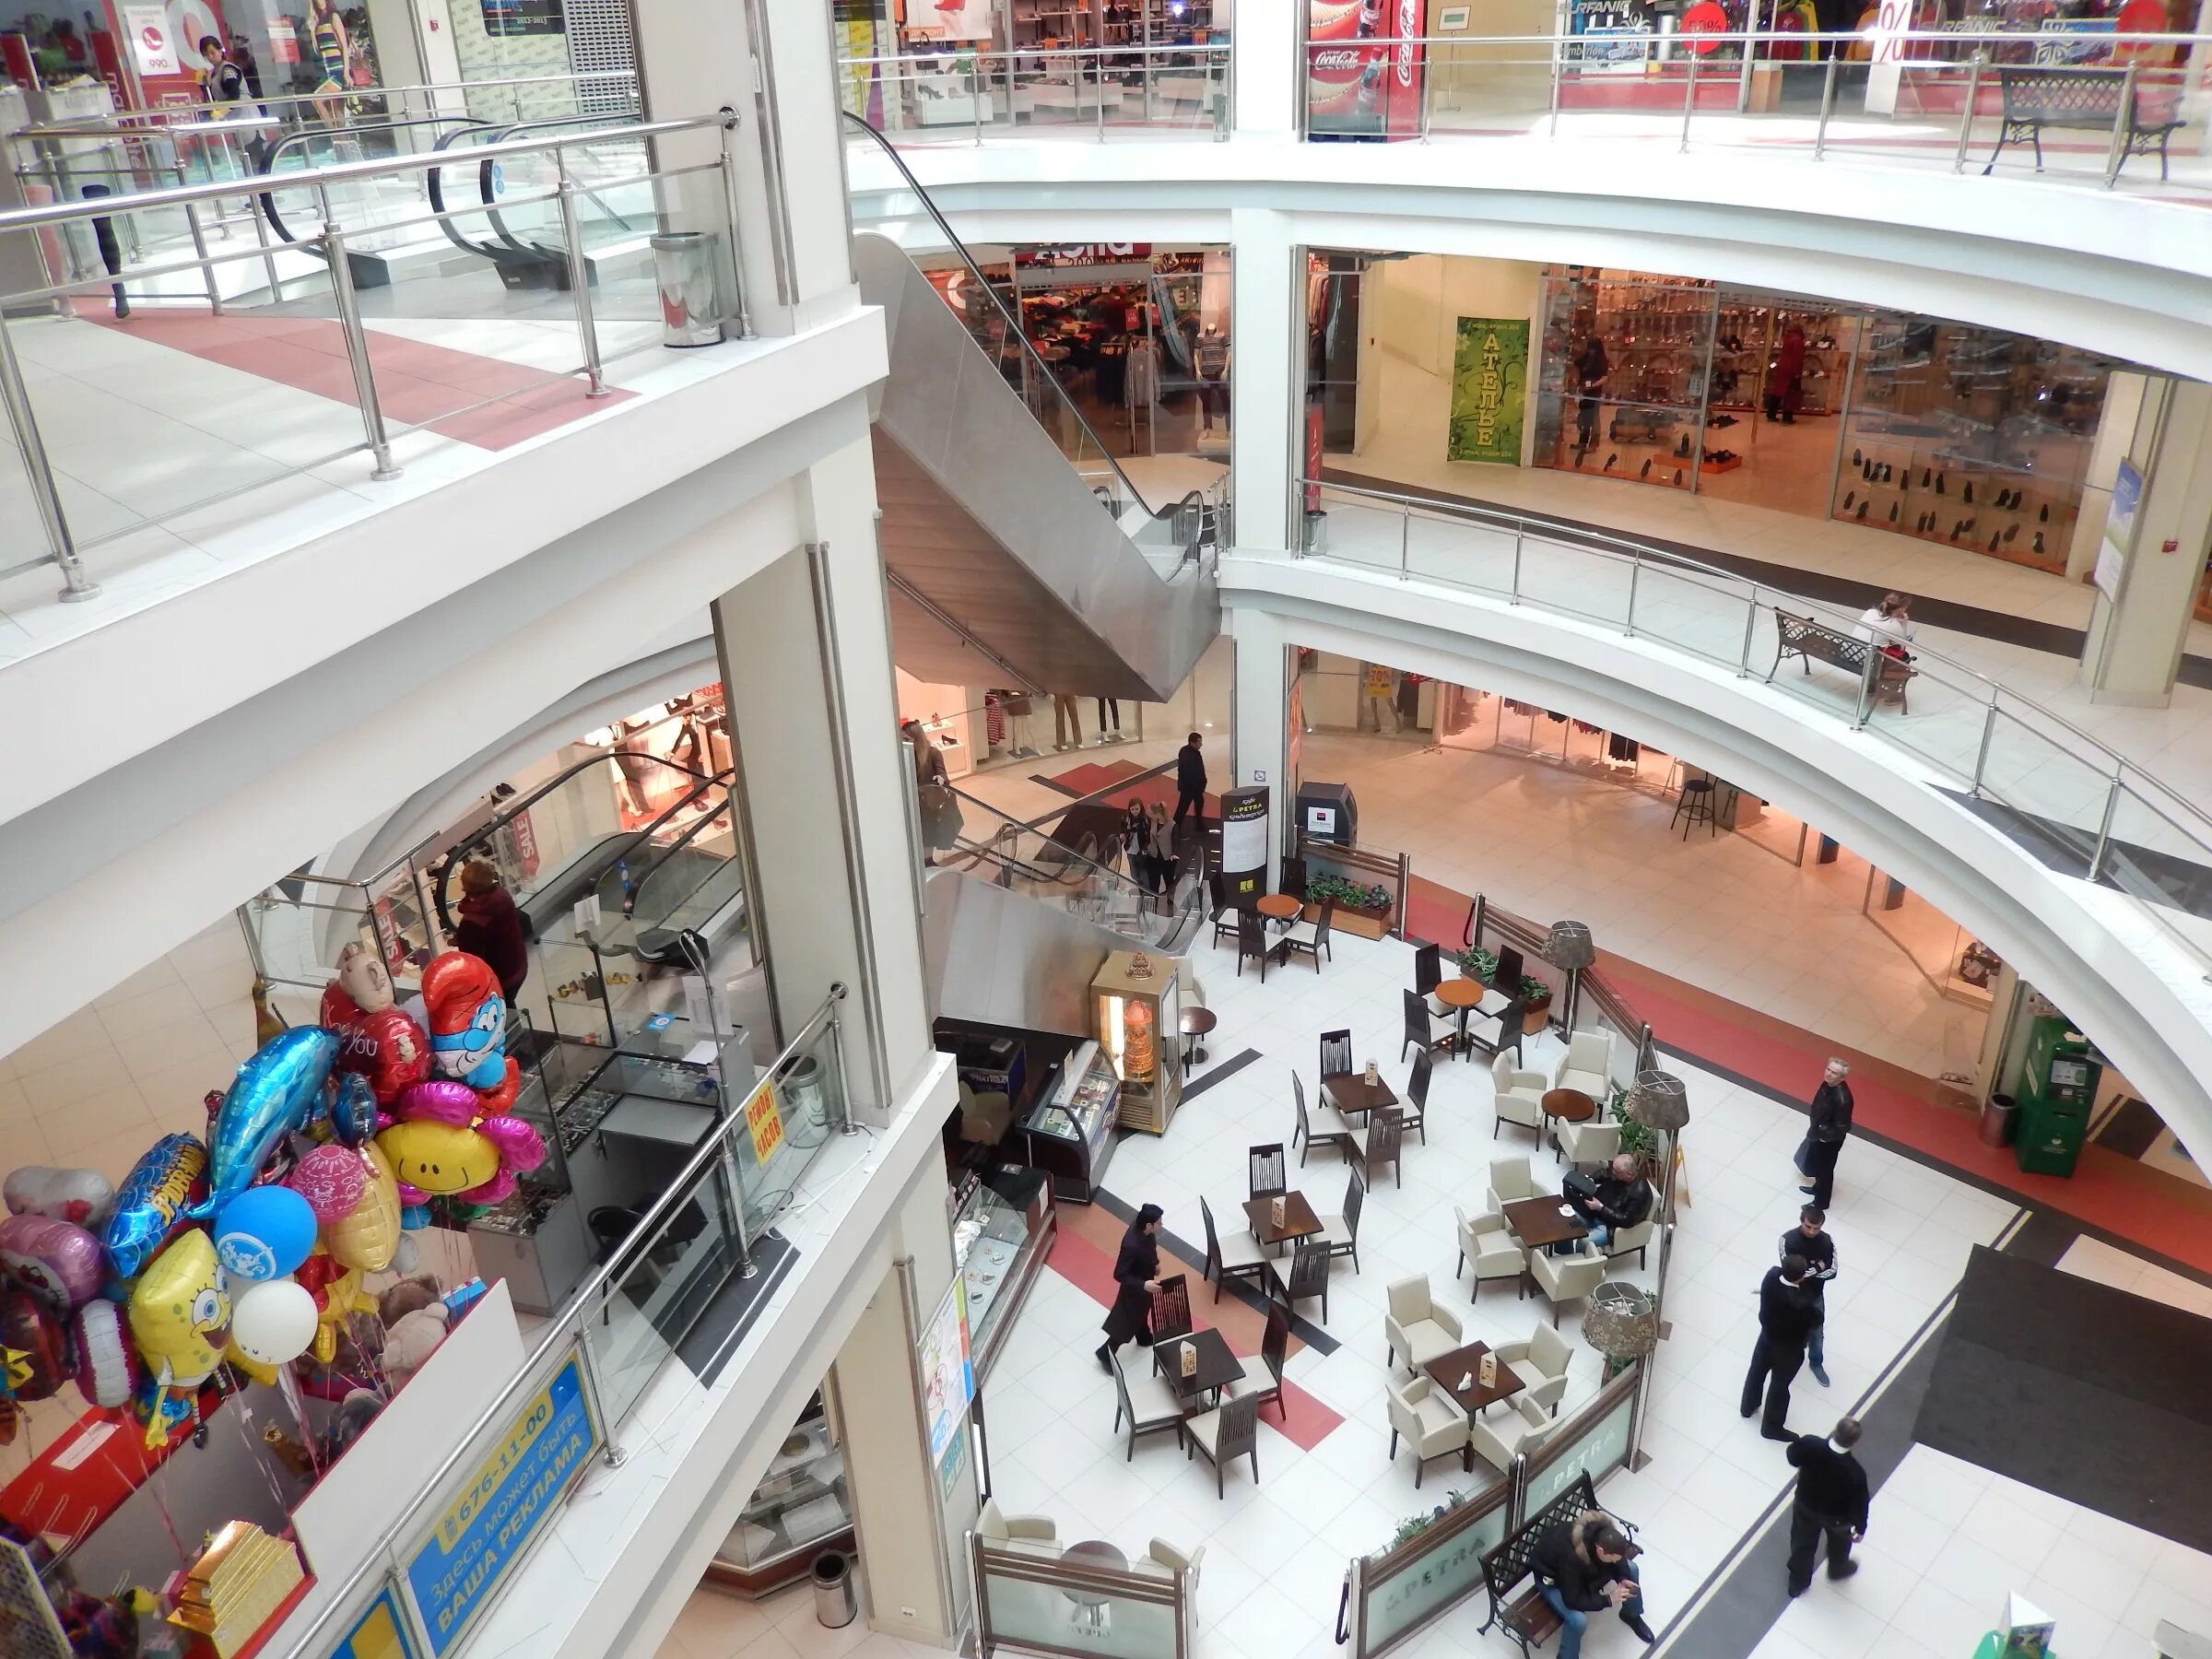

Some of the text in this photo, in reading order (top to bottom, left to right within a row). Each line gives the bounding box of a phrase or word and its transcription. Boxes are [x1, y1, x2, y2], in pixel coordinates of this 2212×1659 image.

[1477, 333, 1500, 447] АТЕЛЬЕ
[1239, 803, 1263, 813] PETRA
[516, 816, 535, 859] SALE
[378, 914, 399, 959] SALE
[747, 1086, 774, 1132] РЕМОНТ
[756, 1115, 782, 1159] ЧАСОВ
[459, 1403, 547, 1523] 676-11-00
[1552, 1430, 1617, 1487] PETRA
[437, 1432, 583, 1633] ВАША РЕКЛАМА
[1403, 1536, 1488, 1602] PETRA
